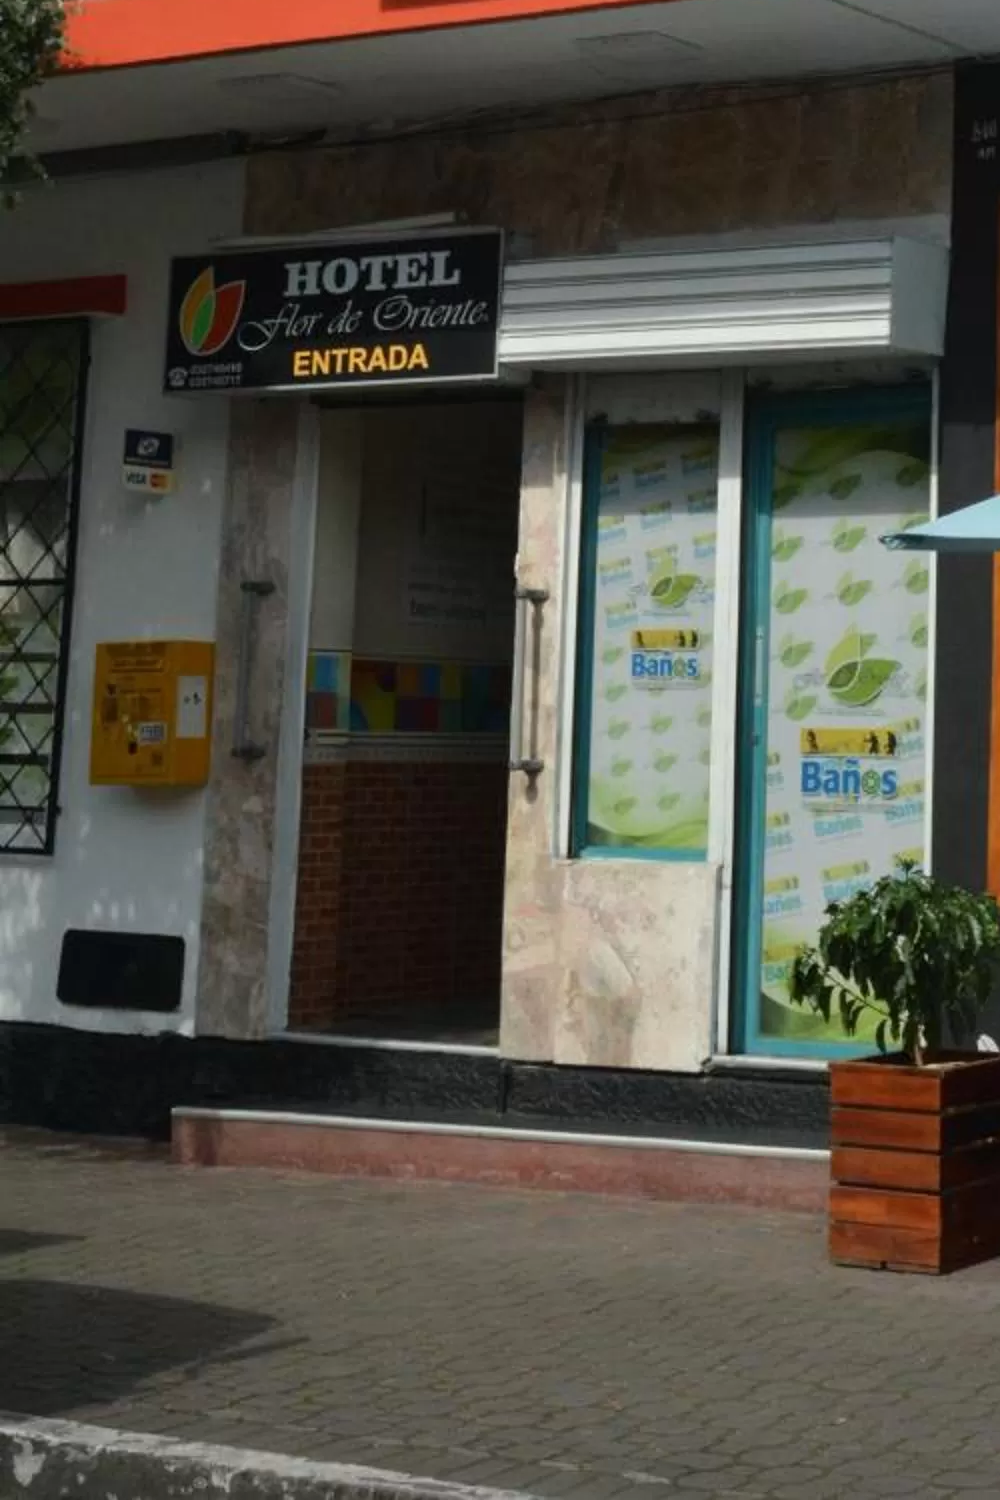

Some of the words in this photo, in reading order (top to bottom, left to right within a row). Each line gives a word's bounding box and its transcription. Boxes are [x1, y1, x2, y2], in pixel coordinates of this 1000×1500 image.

[284, 250, 462, 297] HOTEL
[237, 302, 323, 351] Flor
[327, 299, 363, 334] de
[292, 344, 430, 378] ENTRADA
[127, 472, 147, 485] VISA
[631, 650, 699, 678] Baños
[800, 757, 898, 796] Baños
